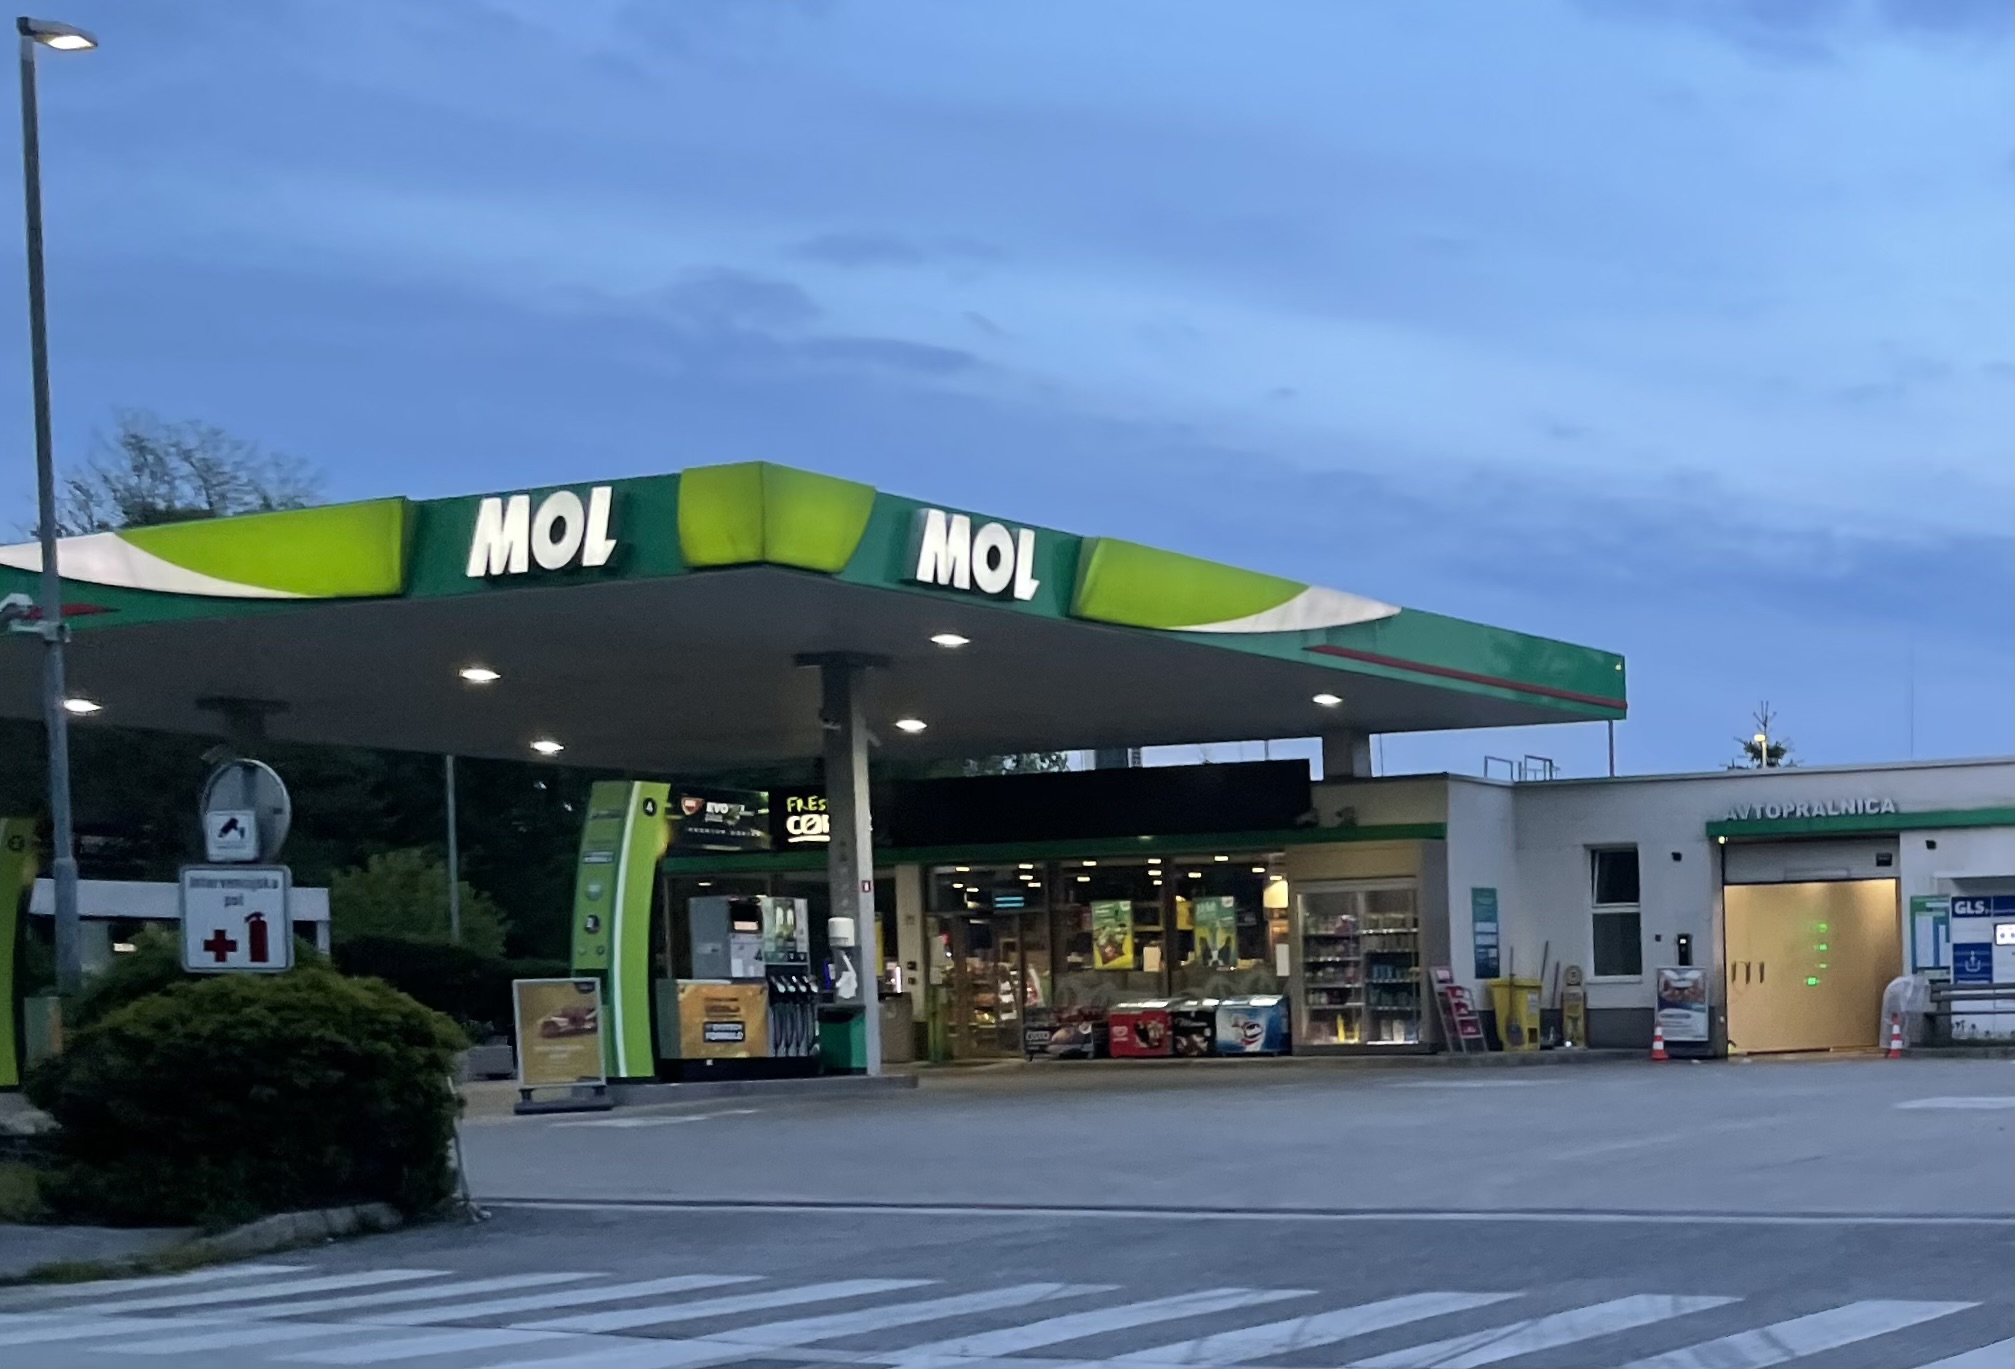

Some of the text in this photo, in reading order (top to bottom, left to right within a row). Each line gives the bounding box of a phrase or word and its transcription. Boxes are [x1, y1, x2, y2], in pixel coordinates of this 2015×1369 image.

[466, 486, 617, 578] MOL
[915, 507, 1040, 601] MOL
[645, 801, 654, 813] 4
[1724, 798, 1896, 820] AVTOPRALNICA
